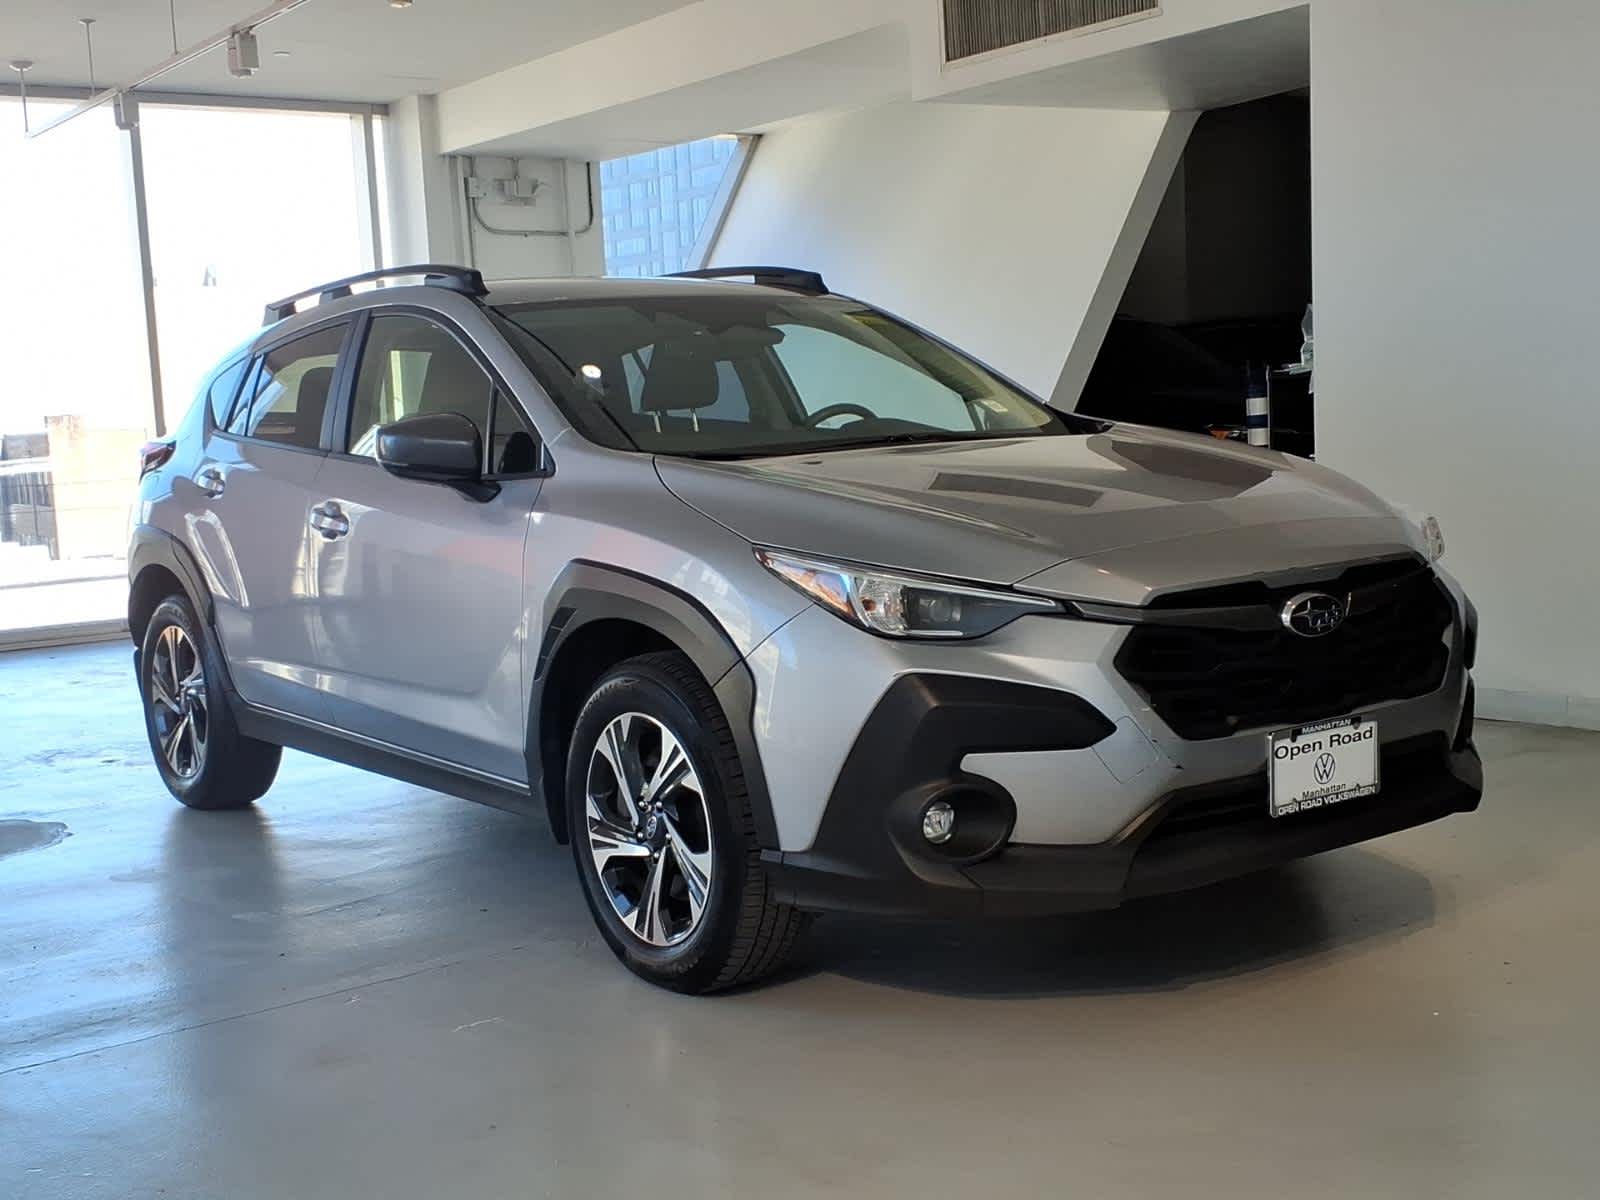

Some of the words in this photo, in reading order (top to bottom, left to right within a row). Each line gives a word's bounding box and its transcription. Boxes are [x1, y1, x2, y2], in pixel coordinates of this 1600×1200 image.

[1301, 719, 1351, 734] MANHATTAN
[1275, 740, 1322, 760] Open
[1329, 726, 1373, 748] Road
[1278, 802, 1299, 816] OPEN
[1300, 799, 1323, 811] ROAD
[1323, 786, 1376, 804] VOLKSWAGEN
[1302, 783, 1346, 800] Manhattan
